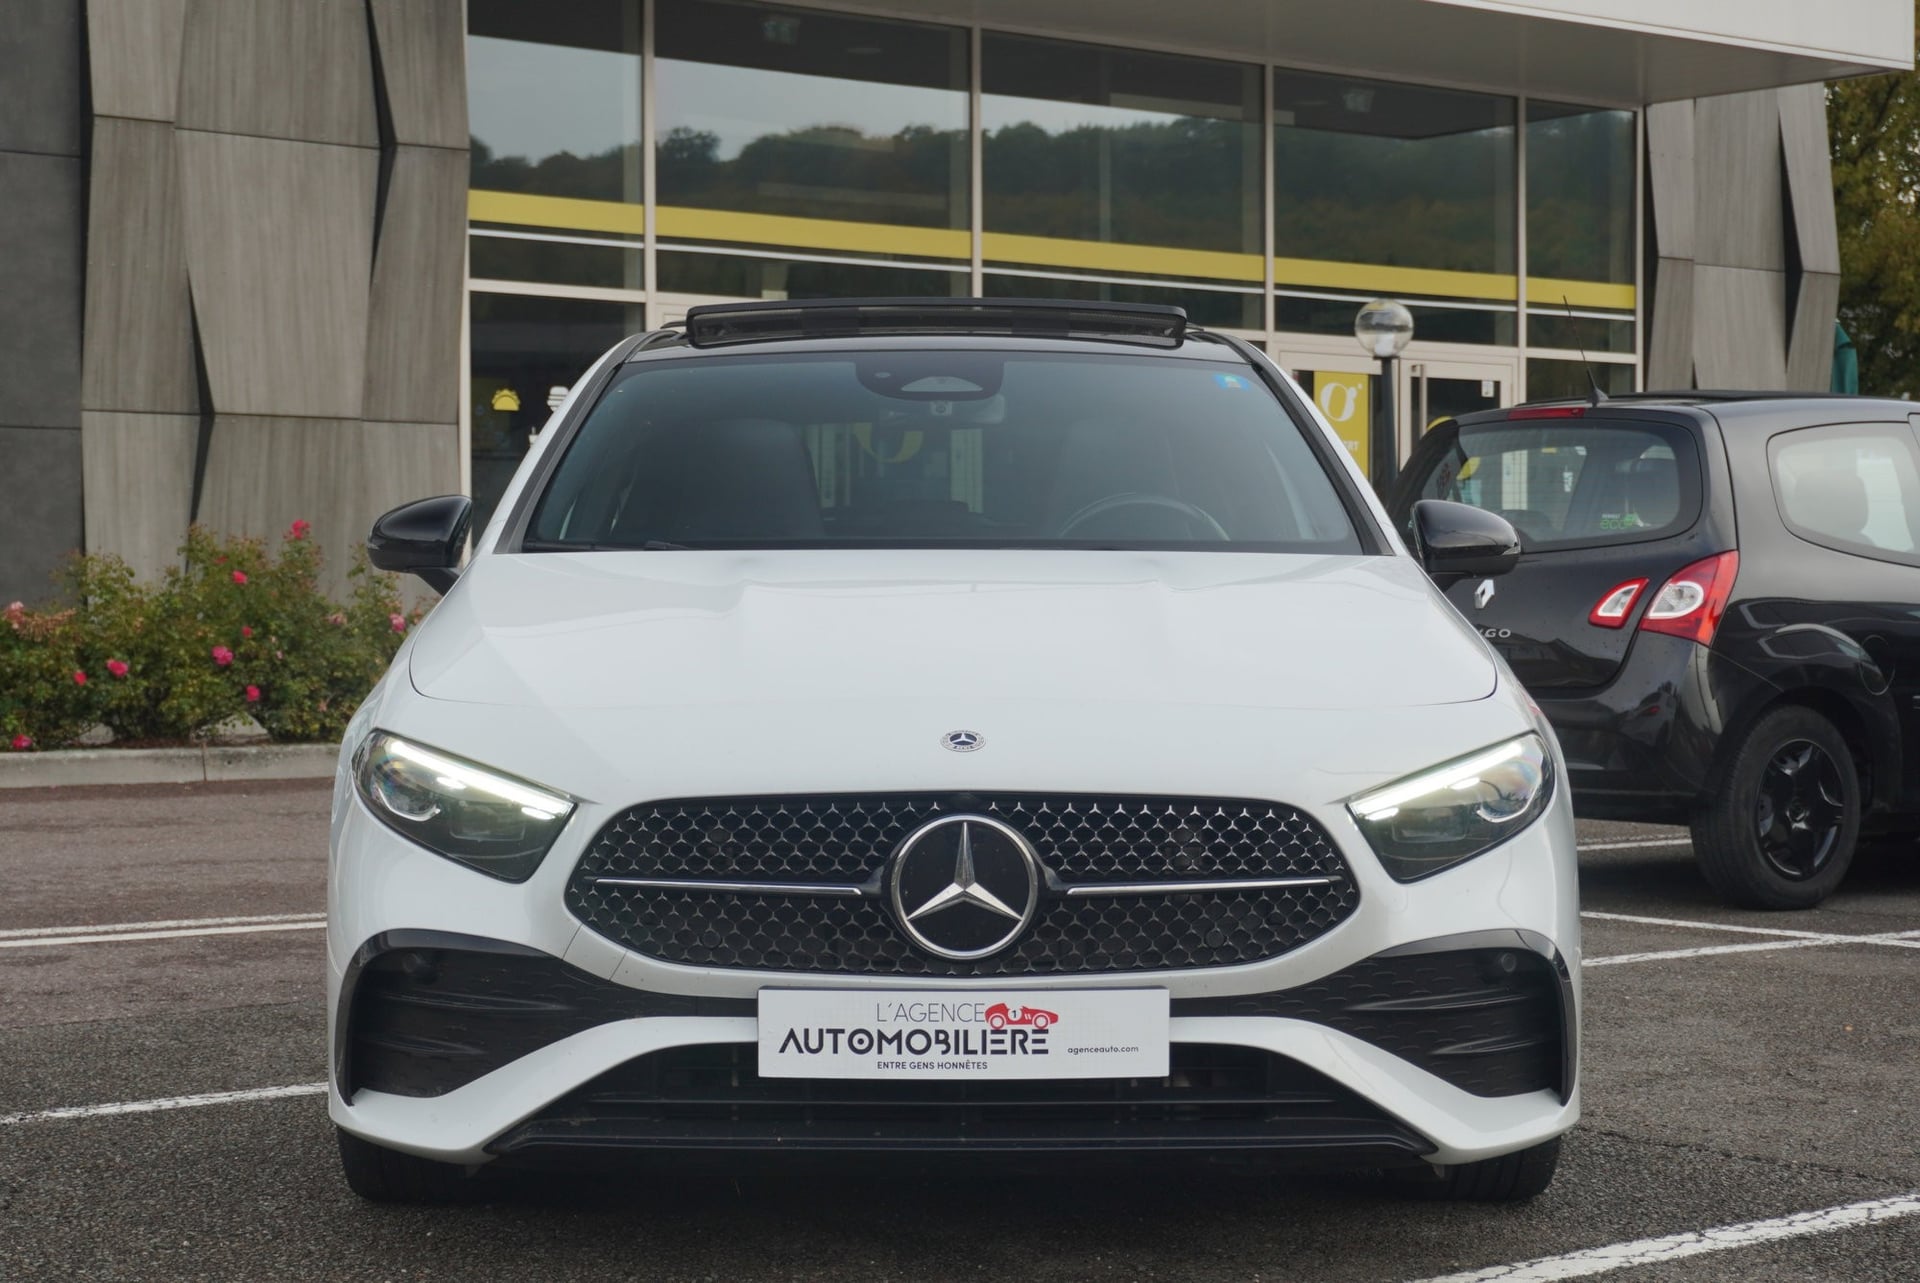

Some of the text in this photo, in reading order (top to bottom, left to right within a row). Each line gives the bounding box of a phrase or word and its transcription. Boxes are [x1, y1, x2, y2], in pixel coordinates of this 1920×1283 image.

[1481, 628, 1511, 638] GO
[877, 1002, 985, 1023] L'AGENCE
[1067, 1045, 1139, 1055] agenceauto.com
[877, 1059, 988, 1070] ENTRE GENS HONNÊTES
